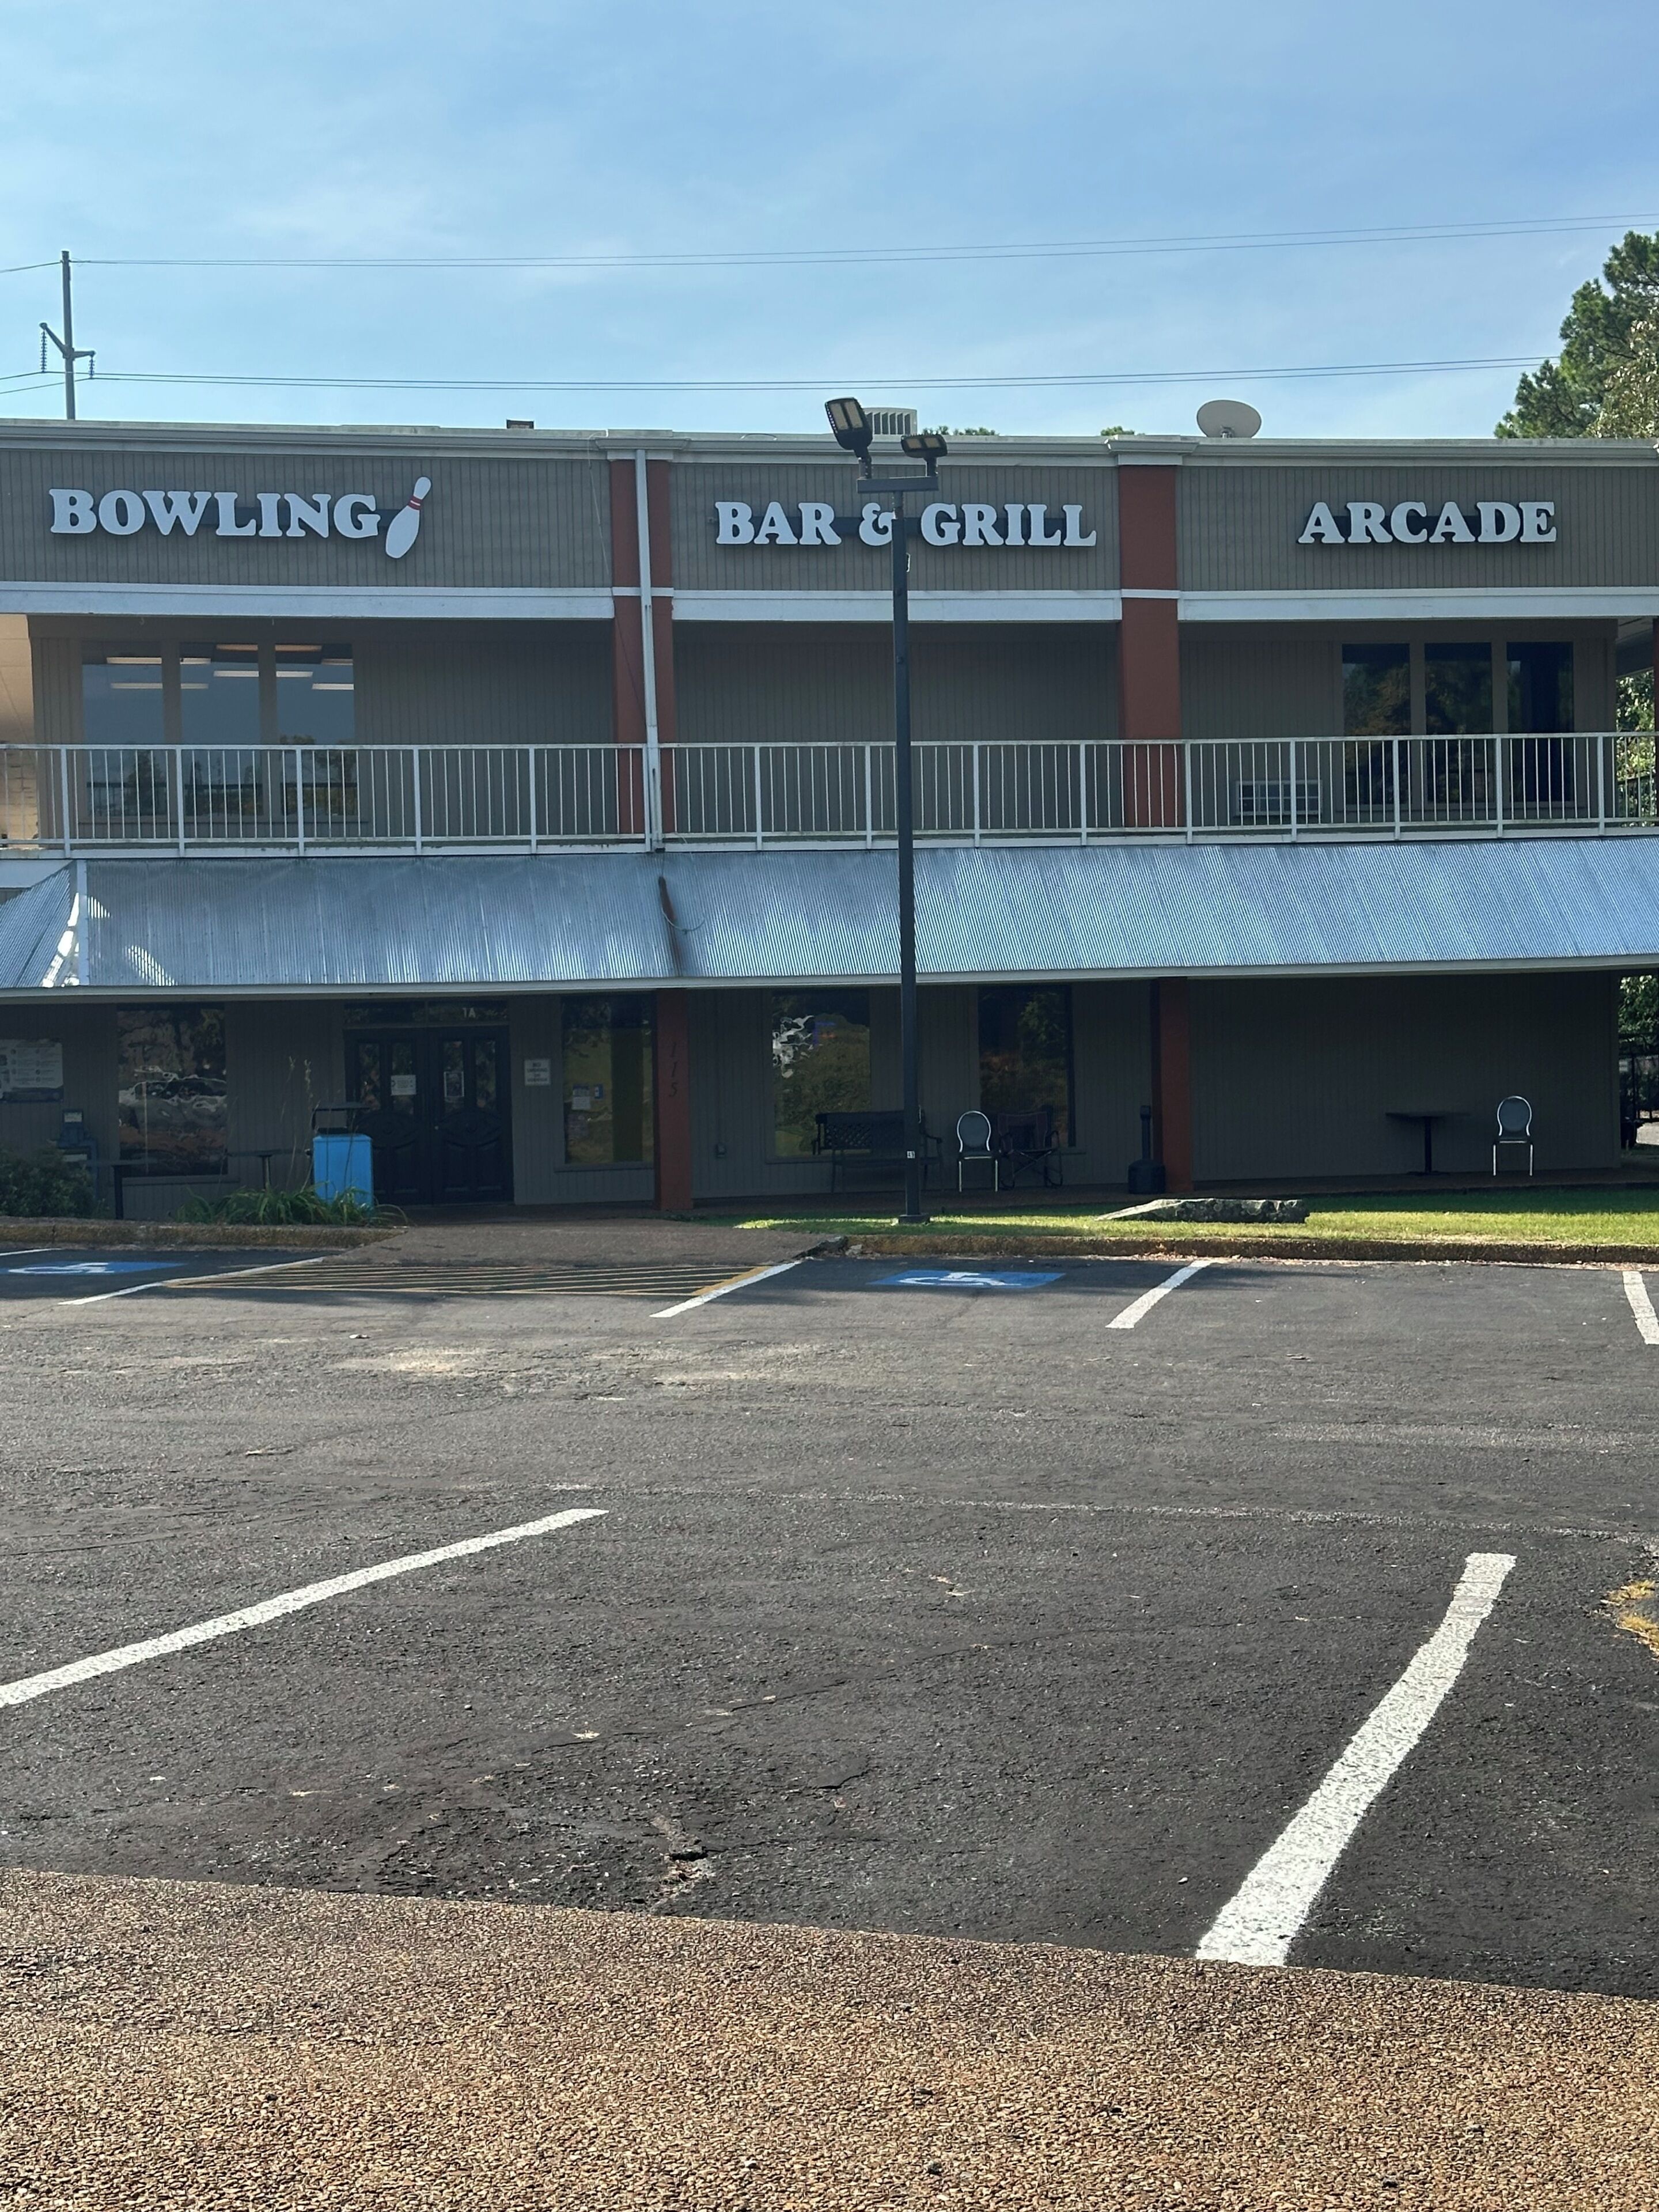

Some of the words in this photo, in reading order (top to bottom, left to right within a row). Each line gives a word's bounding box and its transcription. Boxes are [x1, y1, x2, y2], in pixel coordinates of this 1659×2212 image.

[49, 488, 381, 539] BOWLING
[715, 501, 841, 546] BAR
[859, 502, 897, 546] &
[921, 503, 1096, 546] GRILL
[1297, 502, 1556, 543] ARCADE
